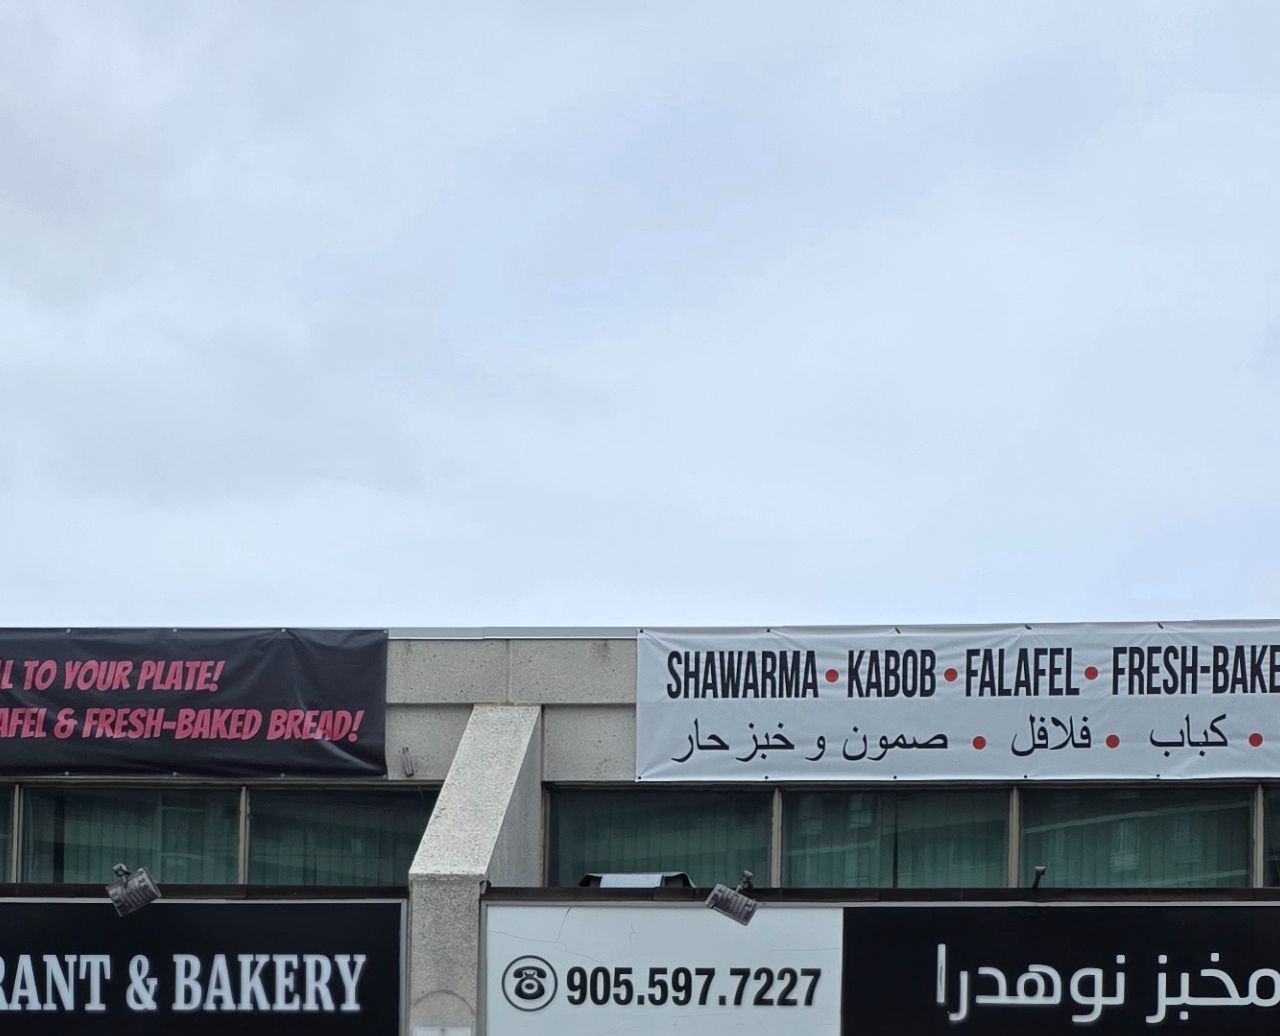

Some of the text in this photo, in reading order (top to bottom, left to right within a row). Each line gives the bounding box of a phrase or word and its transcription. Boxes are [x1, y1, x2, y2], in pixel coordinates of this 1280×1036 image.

[23, 660, 57, 691] TO
[64, 660, 131, 691] YOUR
[137, 660, 226, 692] PLATE!
[667, 651, 820, 699] SHAWARMA
[848, 649, 937, 698] KABOB
[966, 648, 1080, 697] FALAFEL
[54, 708, 78, 739] &
[82, 708, 264, 740] FRESH-BAKED
[266, 709, 366, 743] BREAD!
[671, 717, 730, 763] حار
[735, 721, 796, 763] خبز
[842, 725, 949, 761] صمون
[1011, 714, 1092, 757] فلافل
[1150, 713, 1229, 758] كباب
[805, 735, 827, 762] و
[126, 955, 158, 1013] &
[173, 954, 368, 1013] BAKERY
[566, 966, 823, 1008] 905.597.7227
[934, 943, 1127, 1024] نوهدرا
